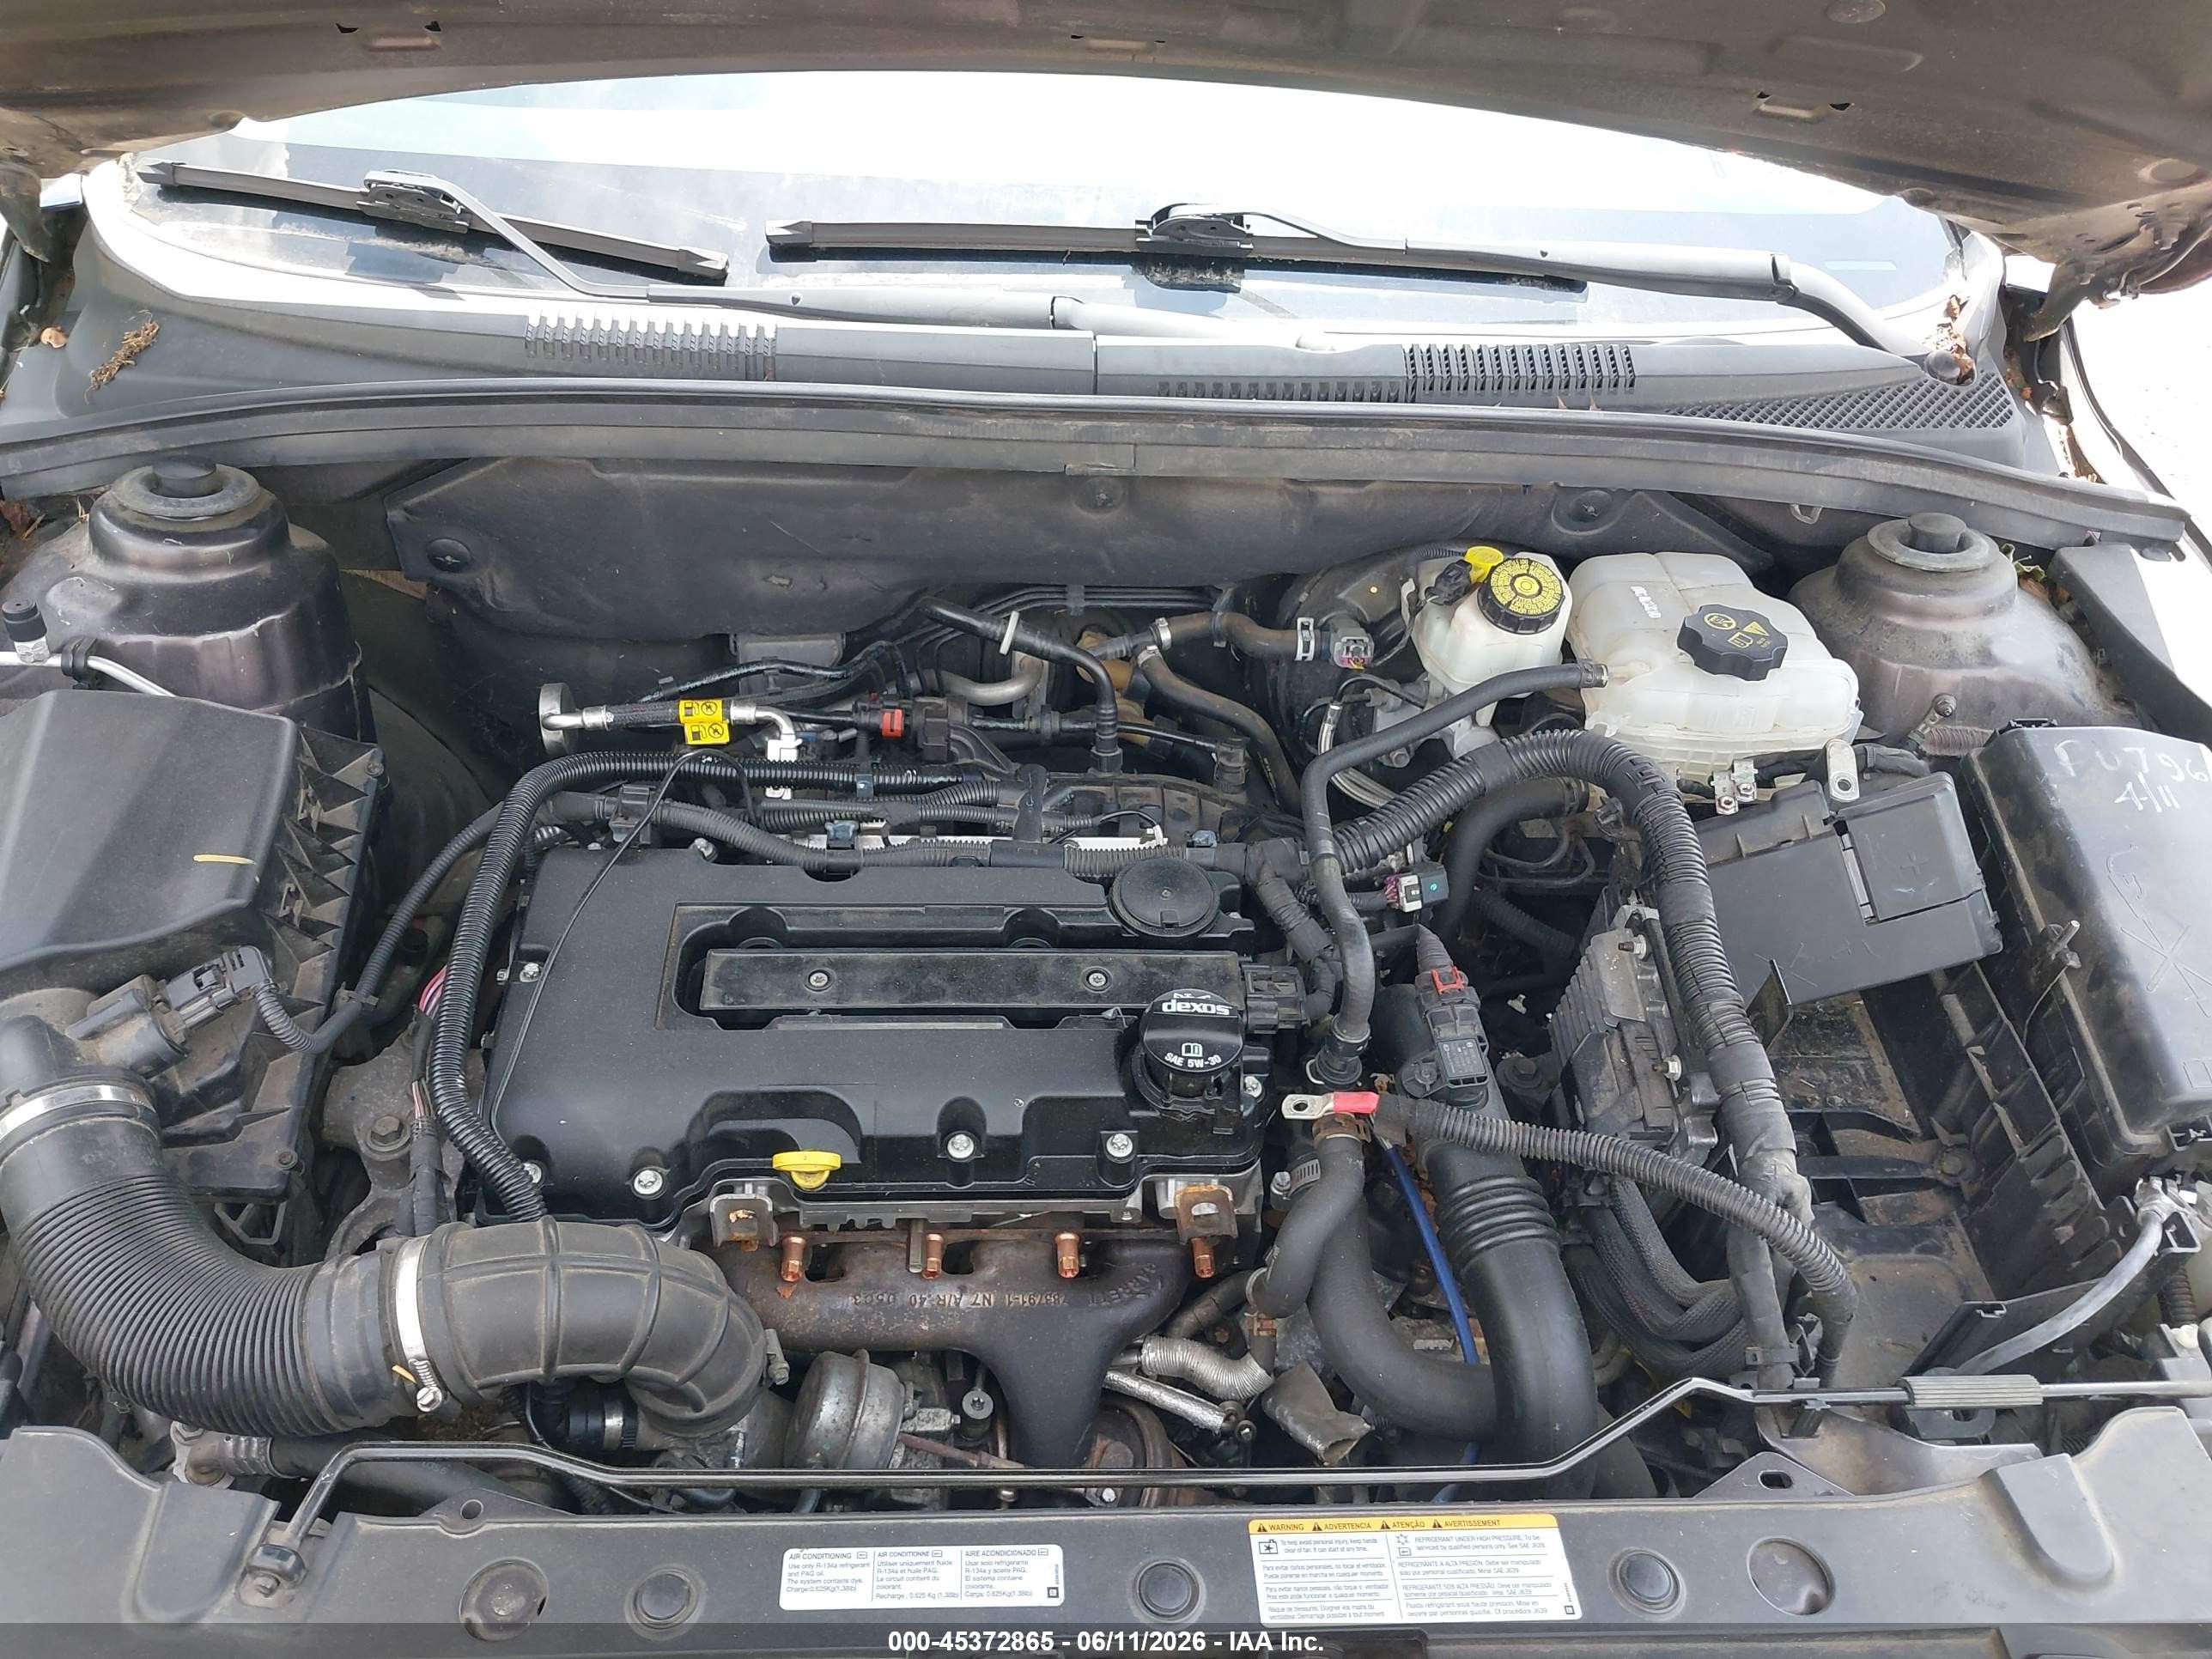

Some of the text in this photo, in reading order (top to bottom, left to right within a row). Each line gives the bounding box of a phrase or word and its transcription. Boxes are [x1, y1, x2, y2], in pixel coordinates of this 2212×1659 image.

[1162, 1000, 1233, 1015] dexos
[1164, 1053, 1221, 1067] SAE 5W-30
[1392, 1519, 1425, 1528] ATENÇÃO
